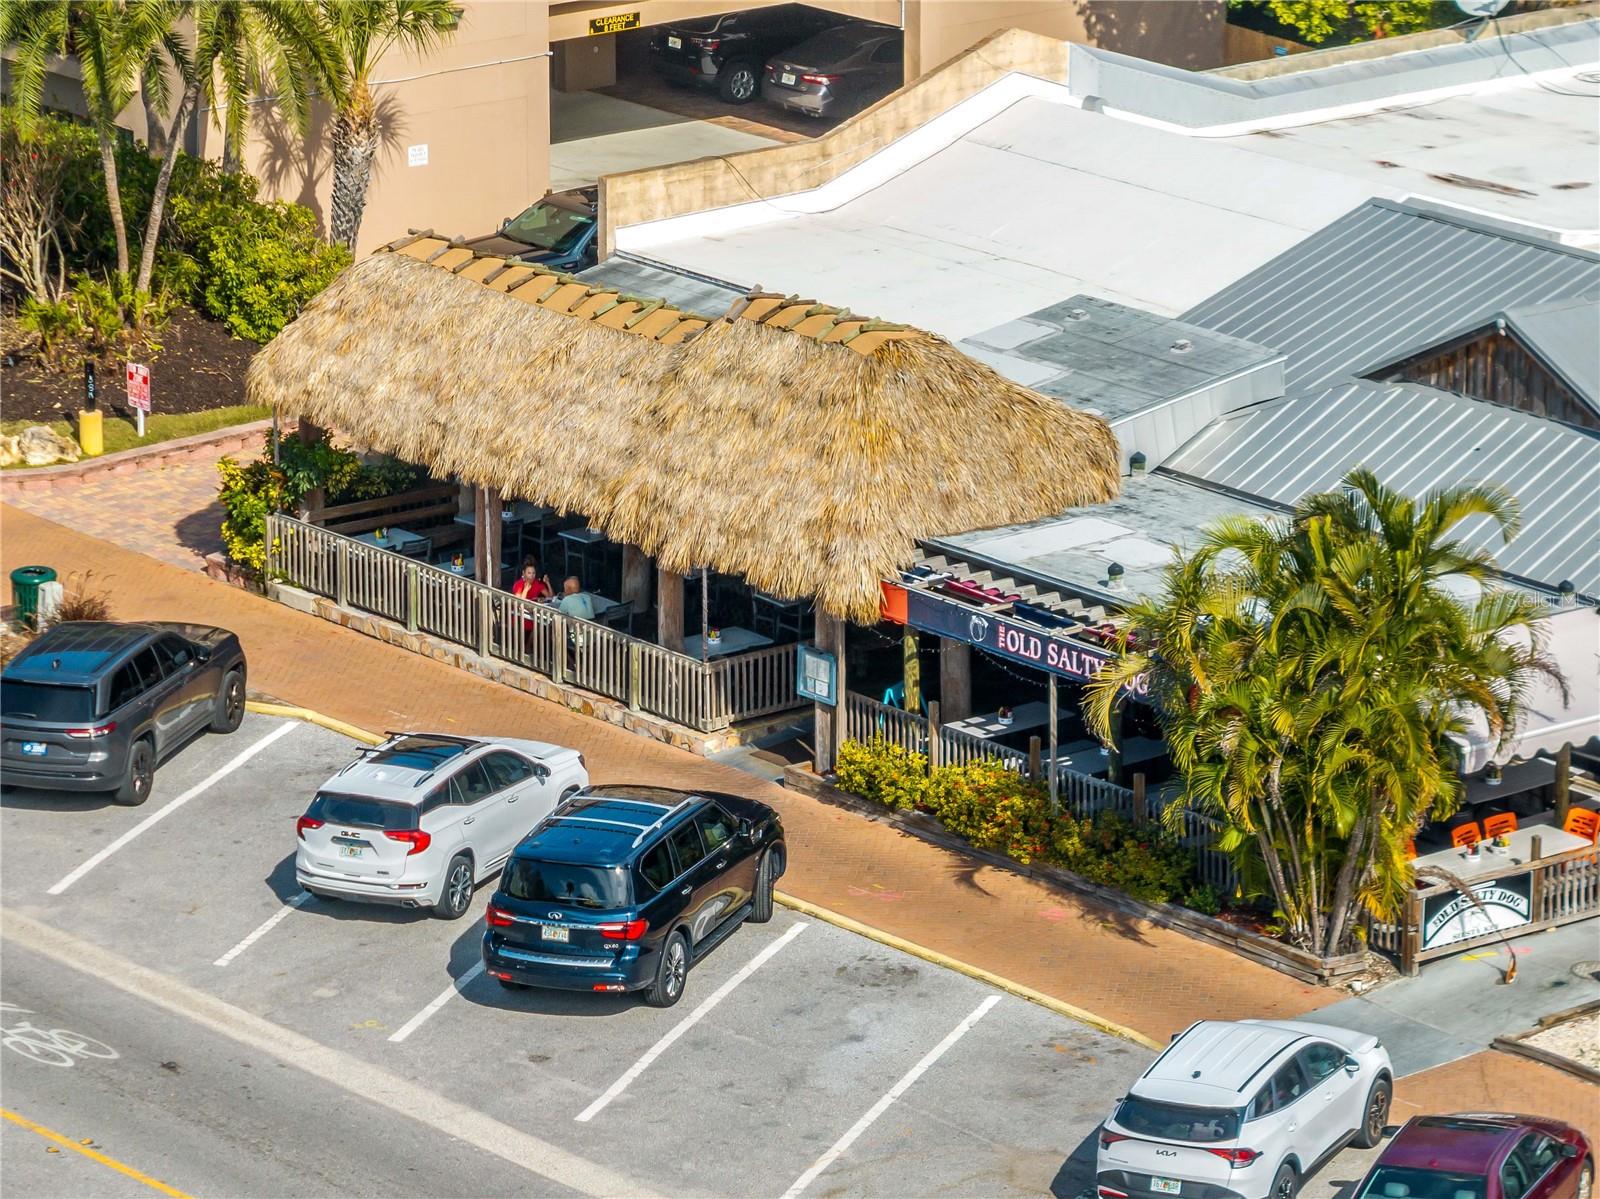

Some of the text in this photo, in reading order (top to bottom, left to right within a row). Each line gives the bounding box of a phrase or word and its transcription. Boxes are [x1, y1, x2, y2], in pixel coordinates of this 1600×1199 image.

[595, 13, 634, 26] CLEARANCE
[610, 21, 626, 32] FEET
[998, 623, 1006, 648] THE
[1006, 629, 1042, 660] OLD
[1047, 643, 1106, 681] SALTY
[340, 830, 361, 839] GMC
[1437, 902, 1460, 924] OLD
[1498, 889, 1523, 909] DOG
